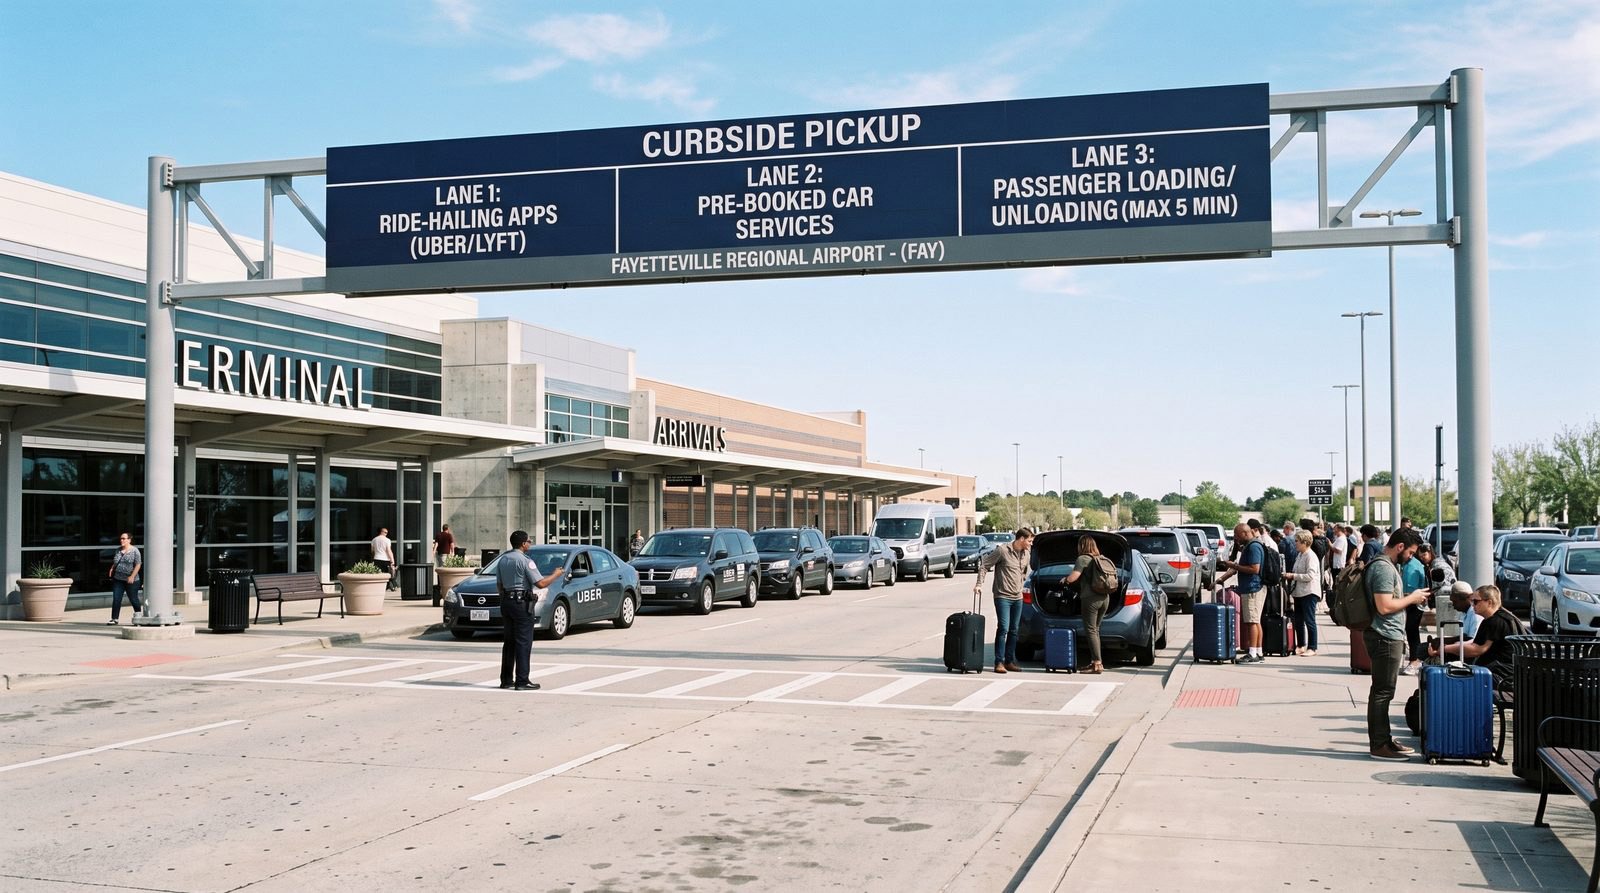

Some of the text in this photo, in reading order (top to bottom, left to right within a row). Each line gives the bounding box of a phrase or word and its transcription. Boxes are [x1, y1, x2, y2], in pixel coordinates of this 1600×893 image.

[643, 113, 921, 158] CURBSIDE PICKUP
[1072, 143, 1155, 168] LANE 3:
[747, 163, 823, 187] LANE 2:
[993, 165, 1237, 199] PASSENGER LOADING/
[435, 183, 501, 206] LANE 1:
[698, 186, 874, 216] PRE-BOOKED CAR
[380, 204, 558, 233] RIDE-HAILING APPS
[992, 193, 1239, 227] UNLOADING (MAX 5 MIN)
[735, 214, 834, 240] SERVICES
[410, 230, 526, 260] (UBER/LYFT)
[611, 253, 722, 274] FAYETTEVILLE
[726, 249, 809, 269] REGIONAL
[812, 245, 886, 265] AIRPORT
[900, 241, 945, 263] (FAY)
[178, 339, 372, 411] ERMINAL
[653, 416, 727, 453] ARRIVALS
[577, 588, 602, 604] UBER
